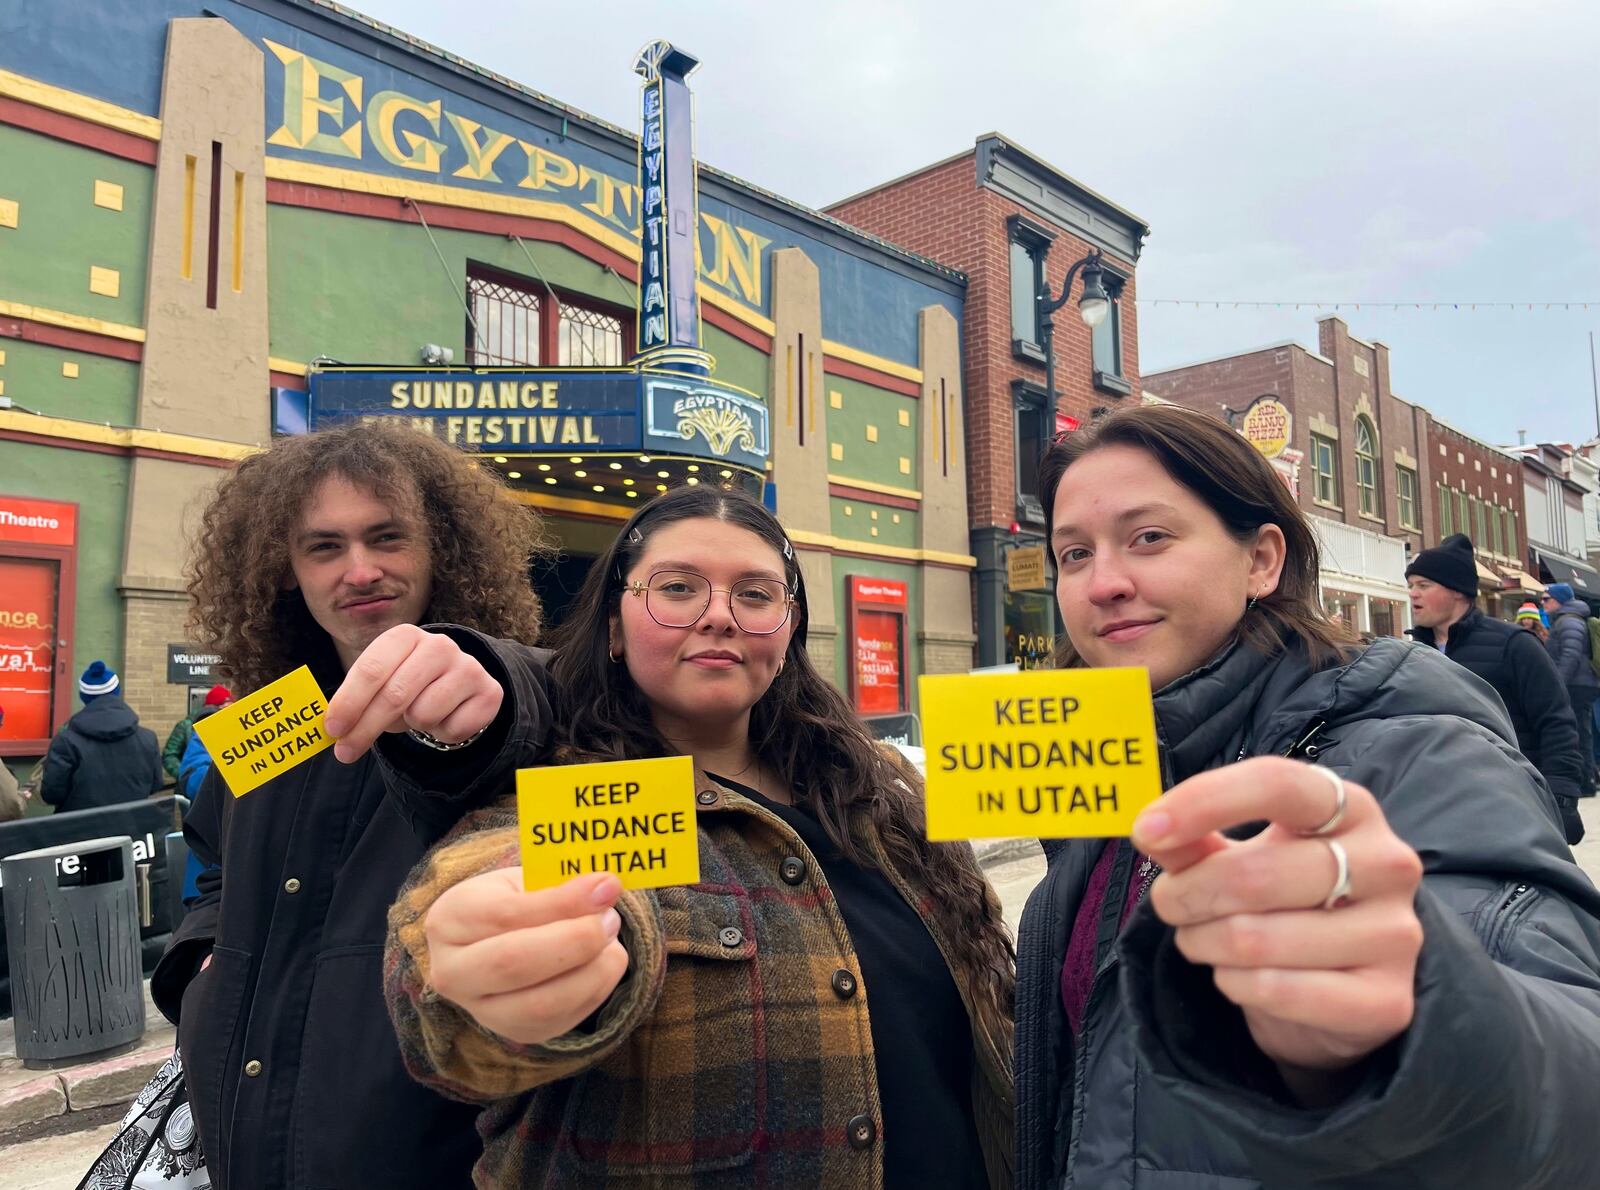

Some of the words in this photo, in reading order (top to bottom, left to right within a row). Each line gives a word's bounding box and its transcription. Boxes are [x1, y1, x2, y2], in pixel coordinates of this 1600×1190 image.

[643, 89, 665, 345] EGYPTIAN
[391, 381, 560, 409] SUNDANCE
[673, 396, 753, 429] EGYPTIAN
[448, 416, 601, 444] FESTIVAL
[1248, 428, 1286, 441] PIZZA
[0, 511, 60, 529] Theatre
[1019, 635, 1054, 653] PARK
[189, 666, 209, 675] LINE
[239, 697, 283, 730] KEEP
[995, 697, 1079, 725] KEEP
[221, 700, 324, 765] SUNDANCE
[250, 759, 268, 774] IN
[269, 727, 322, 764] UTAH
[941, 738, 1142, 771] SUNDANCE
[575, 782, 640, 807] KEEP
[978, 790, 1004, 811] IN
[1018, 784, 1118, 814] UTAH
[532, 812, 685, 845] SUNDANCE
[561, 859, 580, 875] IN
[591, 848, 666, 873] UTAH
